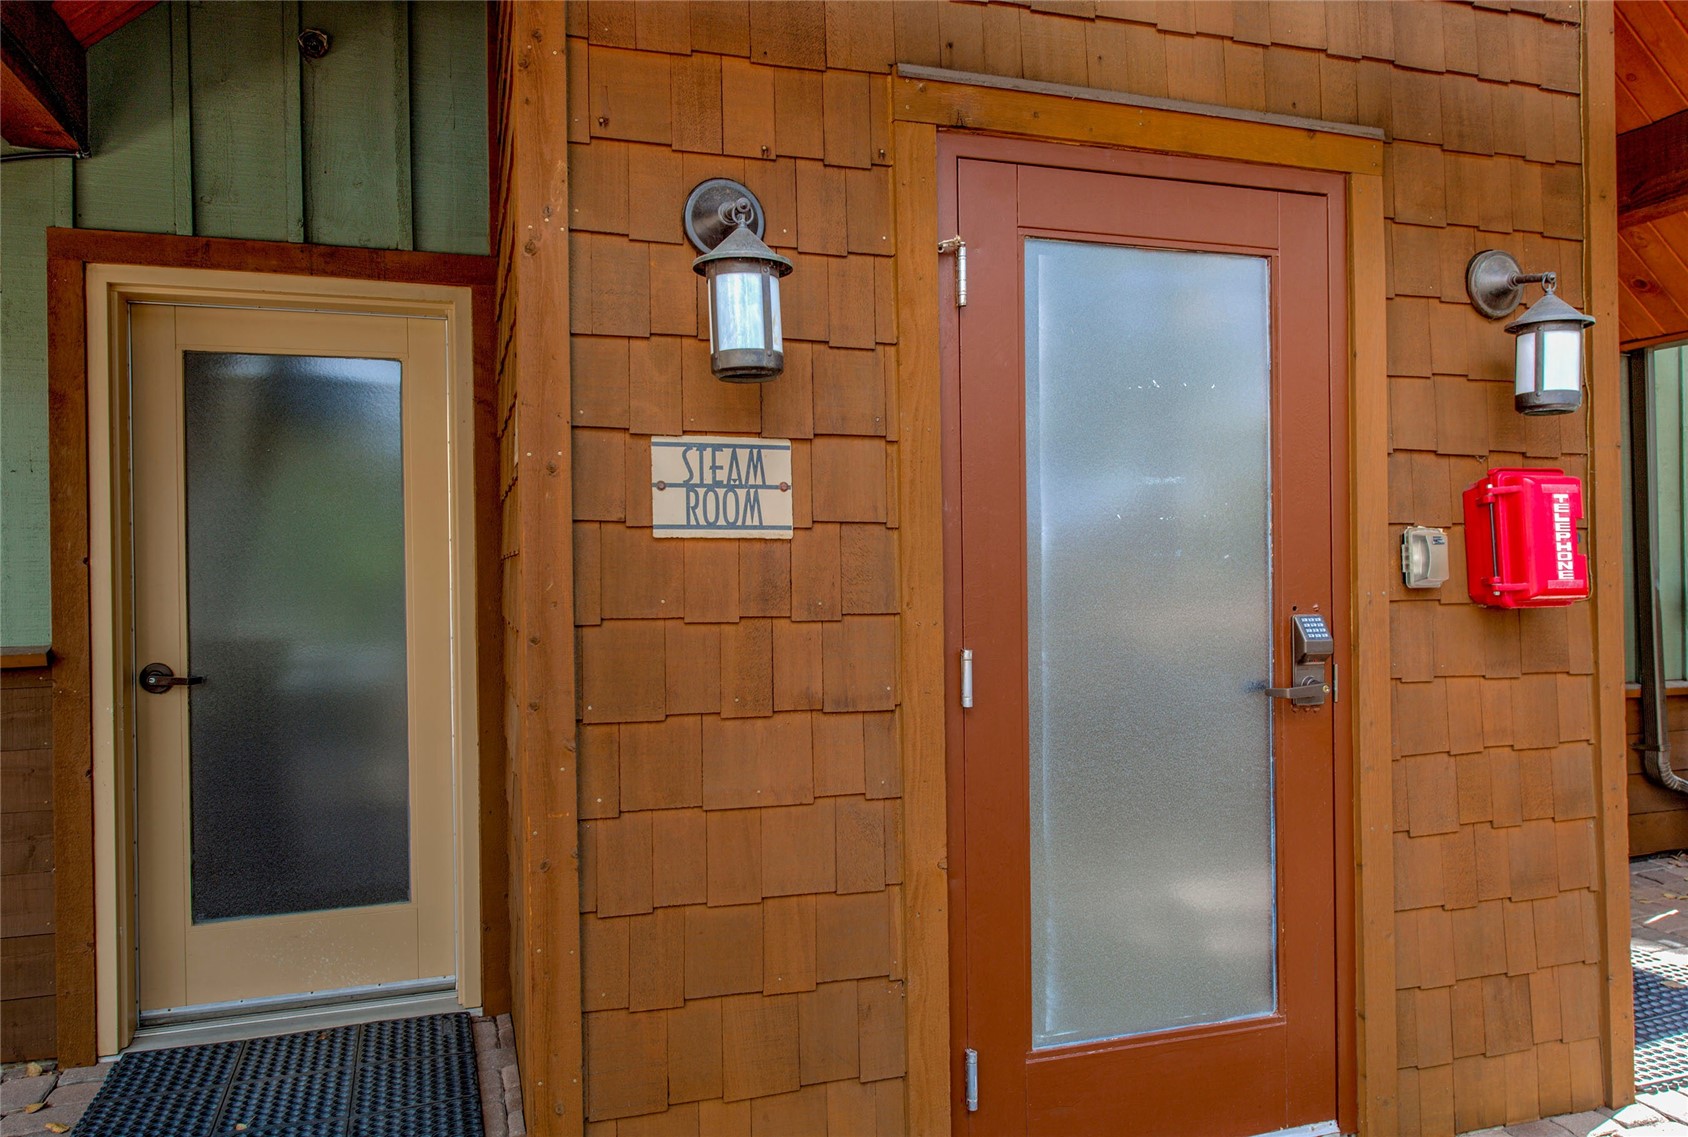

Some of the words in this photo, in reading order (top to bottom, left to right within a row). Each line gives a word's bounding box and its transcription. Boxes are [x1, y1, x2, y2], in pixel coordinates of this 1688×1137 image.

[681, 444, 767, 486] STEAM
[685, 486, 764, 527] ROOM
[1552, 493, 1575, 580] TELEPHONE
